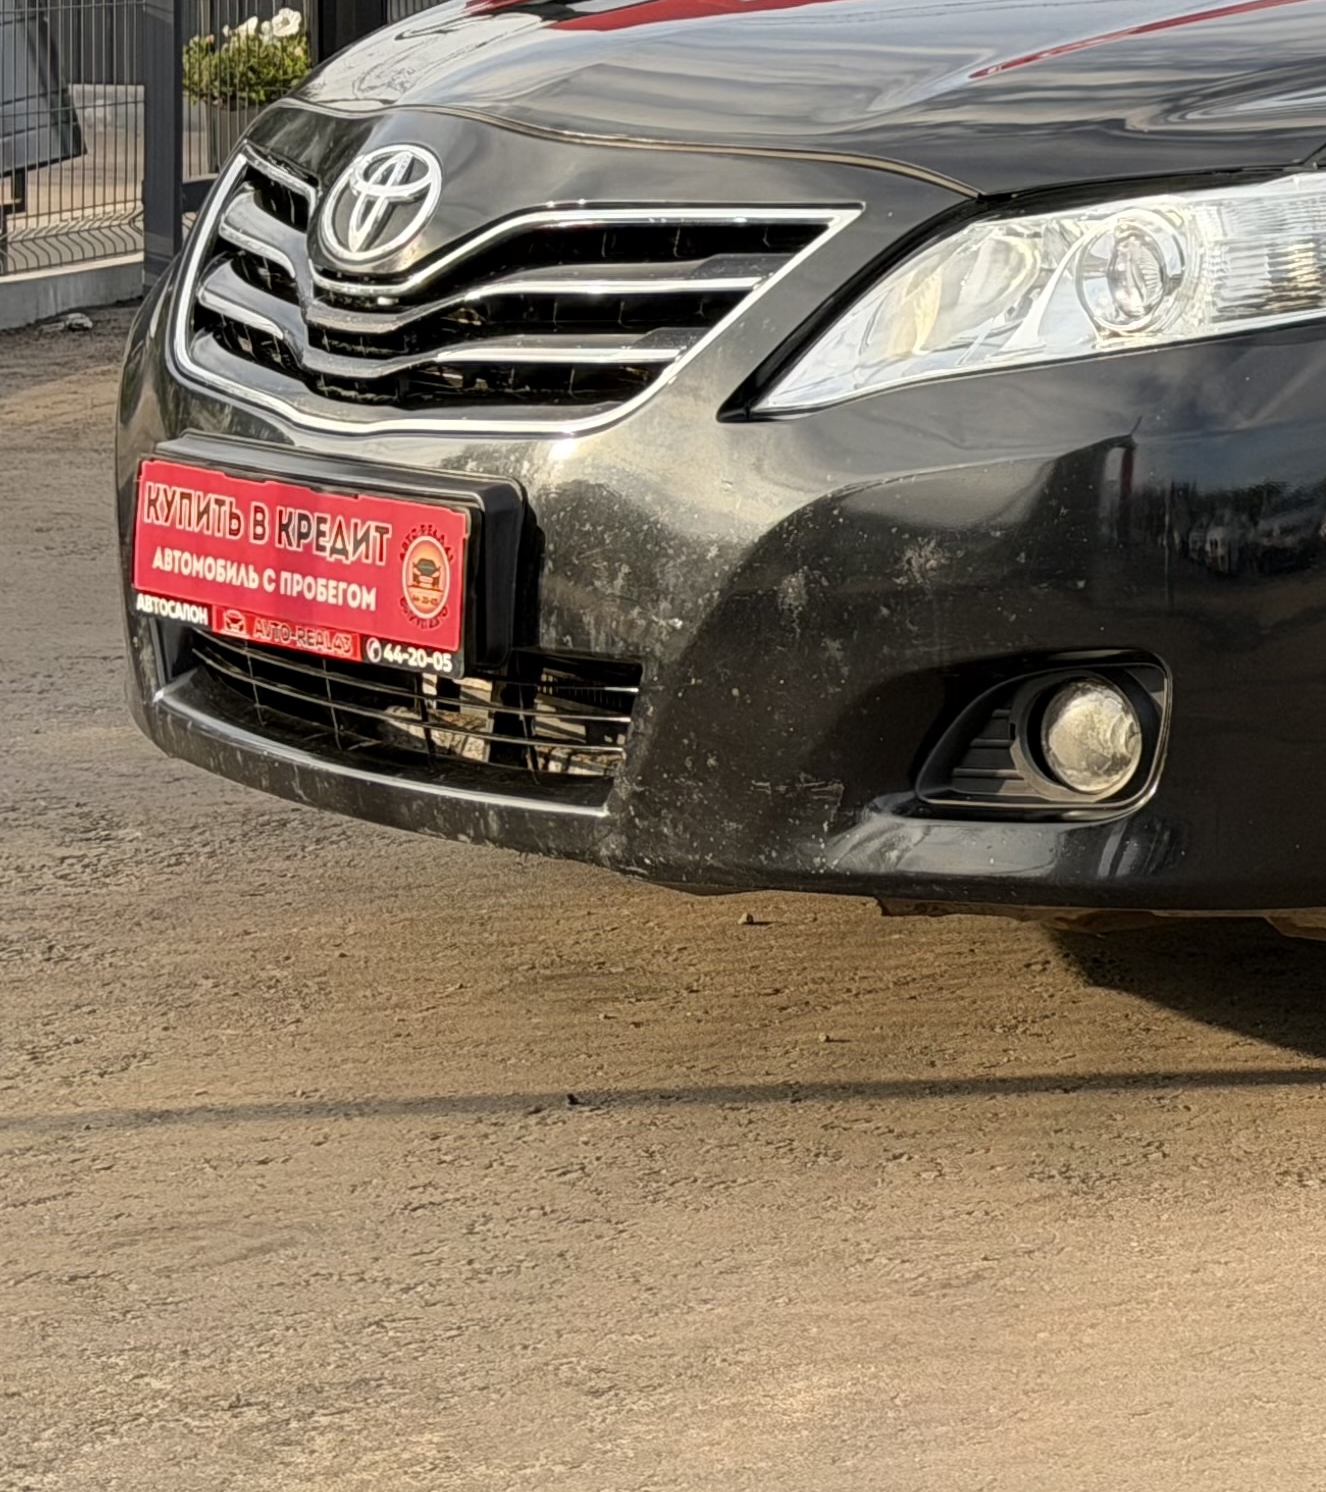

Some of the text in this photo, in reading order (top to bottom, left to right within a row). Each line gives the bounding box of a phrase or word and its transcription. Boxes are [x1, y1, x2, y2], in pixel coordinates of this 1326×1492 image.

[143, 481, 243, 539] КУПИТЬ
[249, 502, 269, 545] В
[275, 506, 393, 565] КРЕДИТ
[152, 546, 377, 611] АВТОМОБИЛЬ С ПРОБЕГОМ
[136, 593, 209, 626] АВТОСАЛОН
[383, 644, 453, 673] 44-20-05
